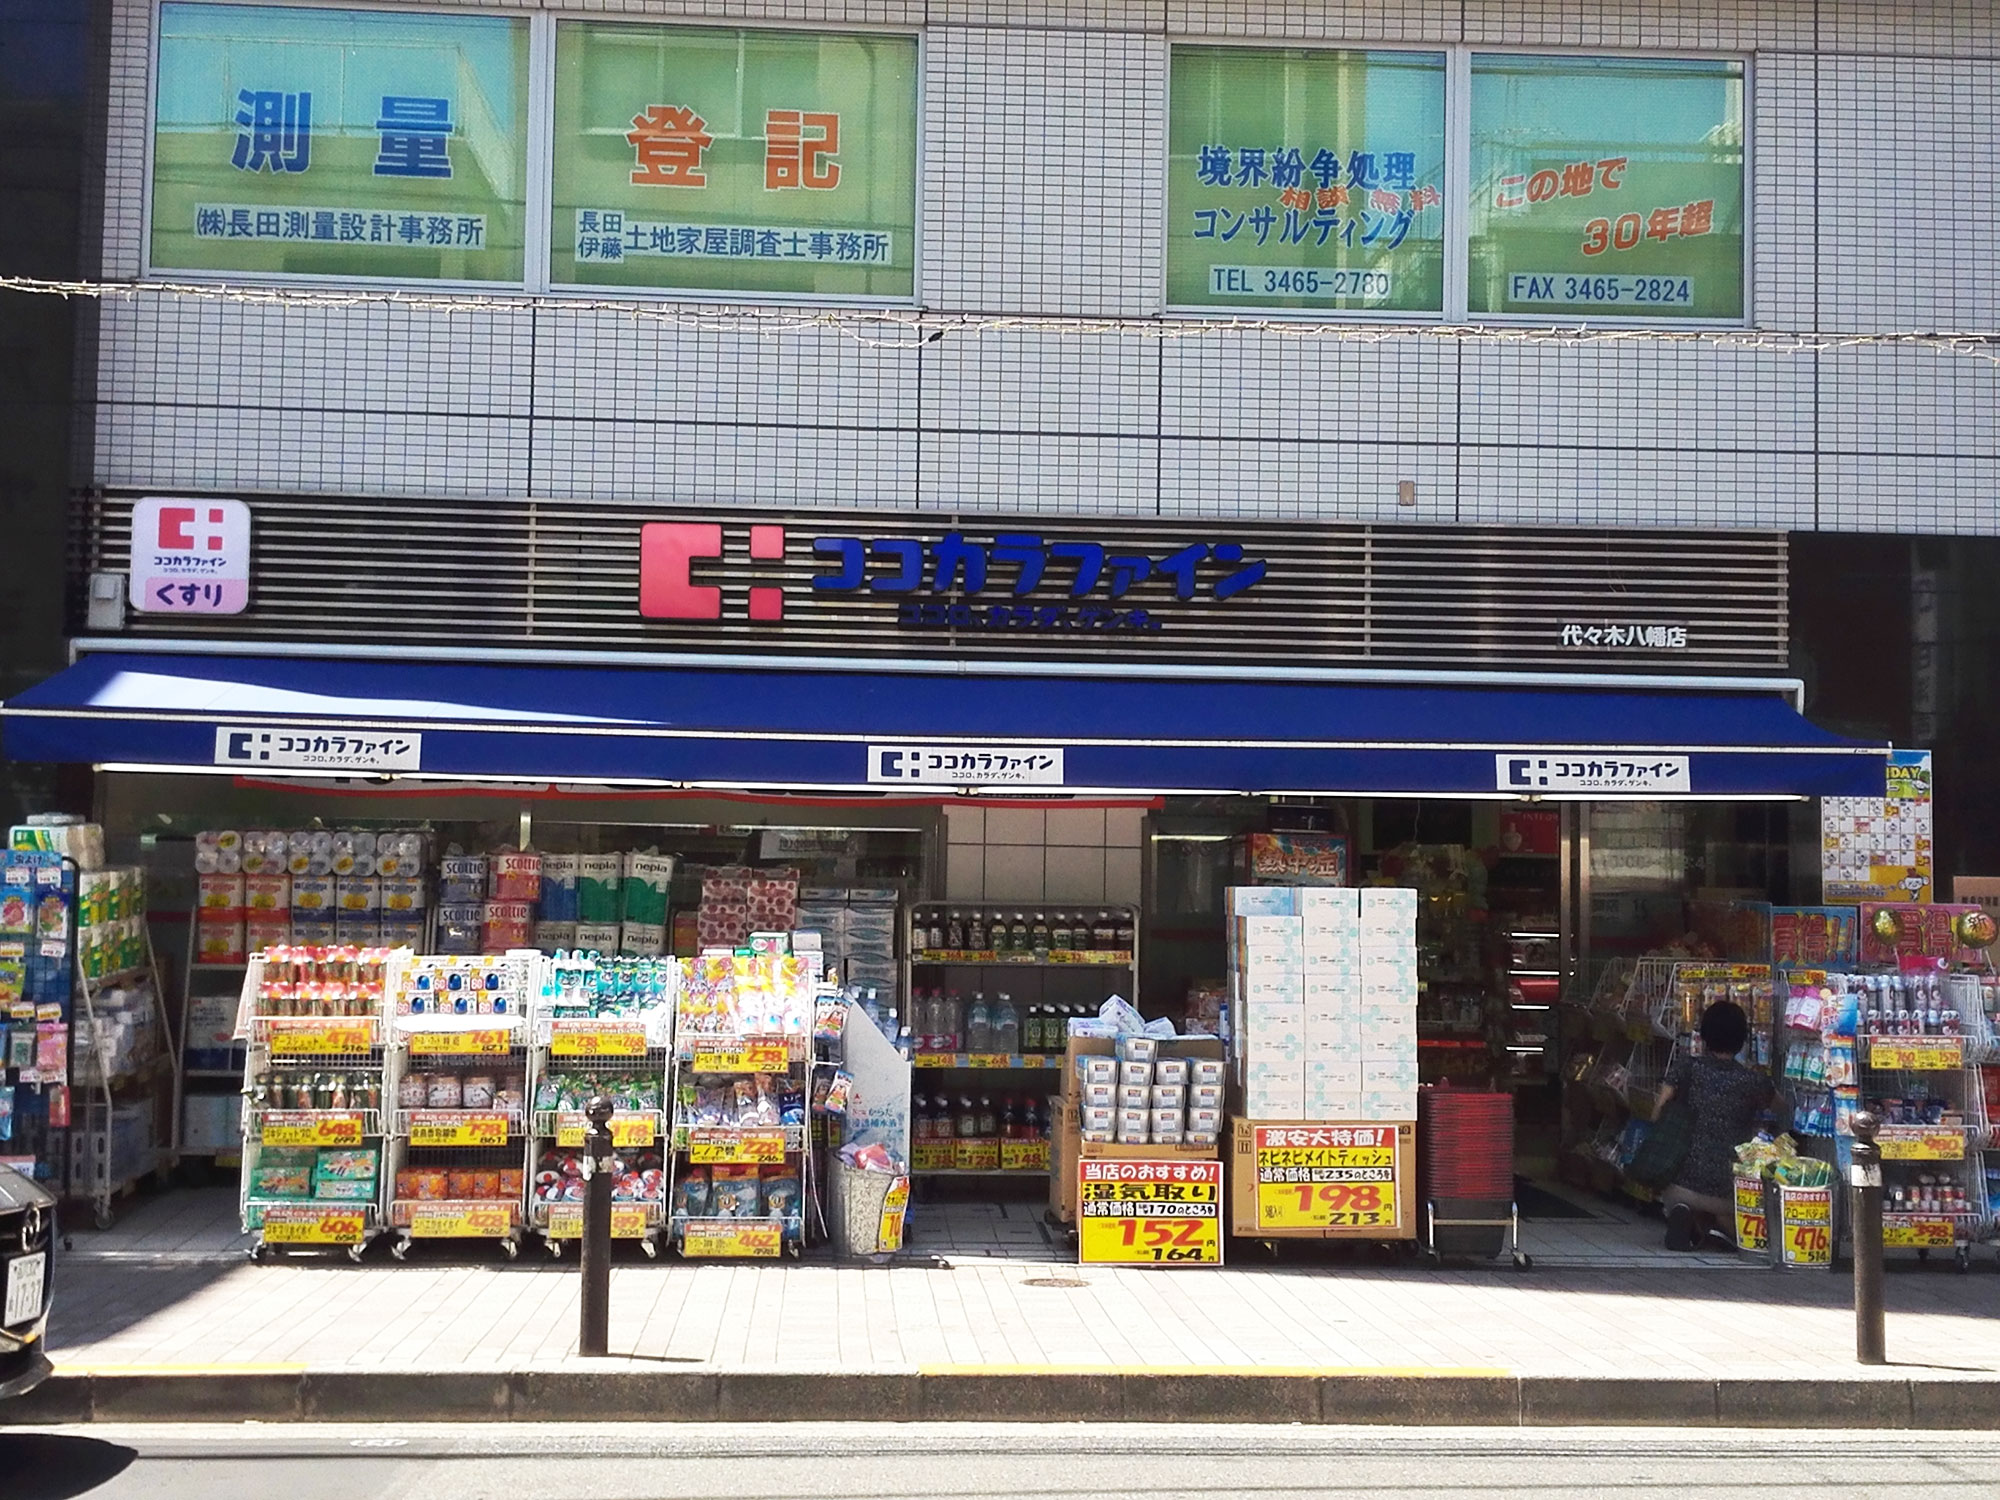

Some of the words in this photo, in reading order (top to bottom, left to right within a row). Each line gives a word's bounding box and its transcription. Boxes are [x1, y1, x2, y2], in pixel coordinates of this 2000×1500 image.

[231, 88, 454, 180] 測量
[623, 103, 843, 193] 登記
[1197, 146, 1417, 192] 境界紛争処理
[1495, 157, 1628, 210] この地で
[579, 211, 622, 235] 長田
[1192, 206, 1415, 251] コンサルティング
[578, 236, 623, 262] 伊藤
[624, 225, 891, 262] 土地家屋調査士事務所
[1214, 269, 1254, 293] TEL
[1264, 270, 1390, 297] 3465-2780
[1513, 275, 1554, 300] FAX
[1565, 277, 1690, 302] 3465-2824
[153, 556, 228, 569] ココカラファイン
[812, 532, 1268, 601] ココカラファイン
[155, 584, 223, 607] くすり
[1560, 624, 1688, 650] 代々木八幡店
[278, 736, 411, 757] ココカラファイン
[928, 752, 1055, 773] ココカラファイン
[1555, 760, 1681, 779] ココカラファイン
[1265, 1129, 1385, 1147] 激安大特価!
[1259, 1150, 1392, 1166] ネピネピメイトティッシュ
[1085, 1163, 1215, 1182] 当店のおすすめ!
[1260, 1168, 1311, 1182] 通常価格
[1084, 1183, 1216, 1201] 湿気取り
[1295, 1185, 1381, 1211] 198
[1083, 1202, 1135, 1217] 通常価格
[1329, 1213, 1380, 1225] 213
[1118, 1219, 1204, 1247] 152
[1151, 1248, 1203, 1261] 164
